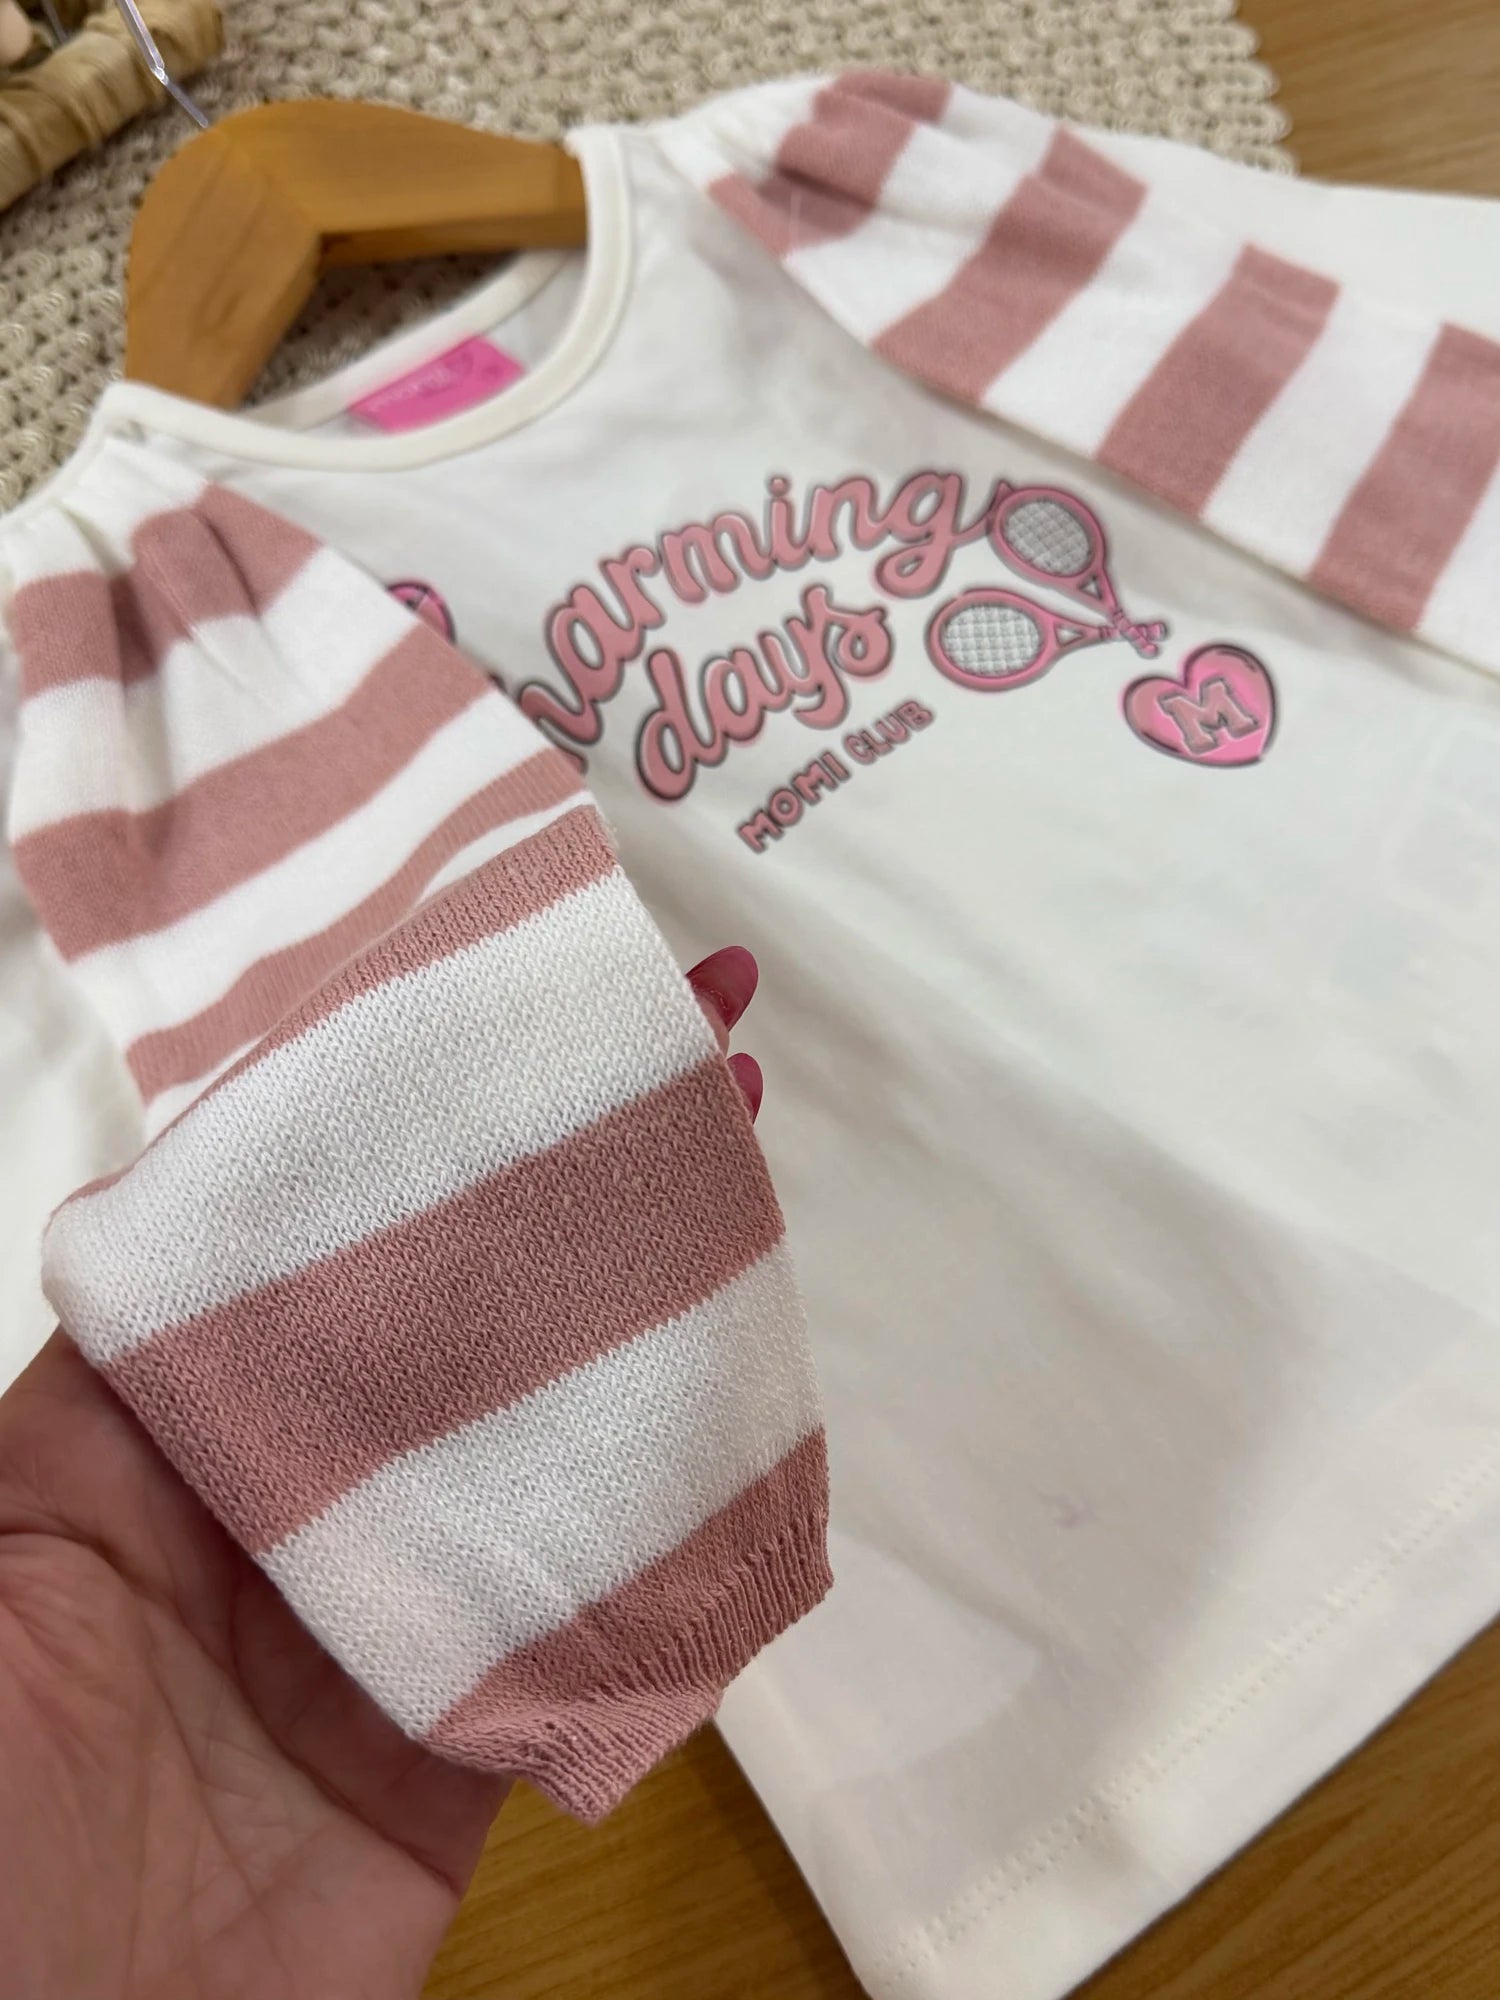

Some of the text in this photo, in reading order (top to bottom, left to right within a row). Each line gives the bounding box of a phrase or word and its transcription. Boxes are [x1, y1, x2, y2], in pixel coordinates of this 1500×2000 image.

[635, 583, 894, 803] days
[1156, 675, 1259, 756] M
[737, 698, 936, 855] MOMI CLUB
